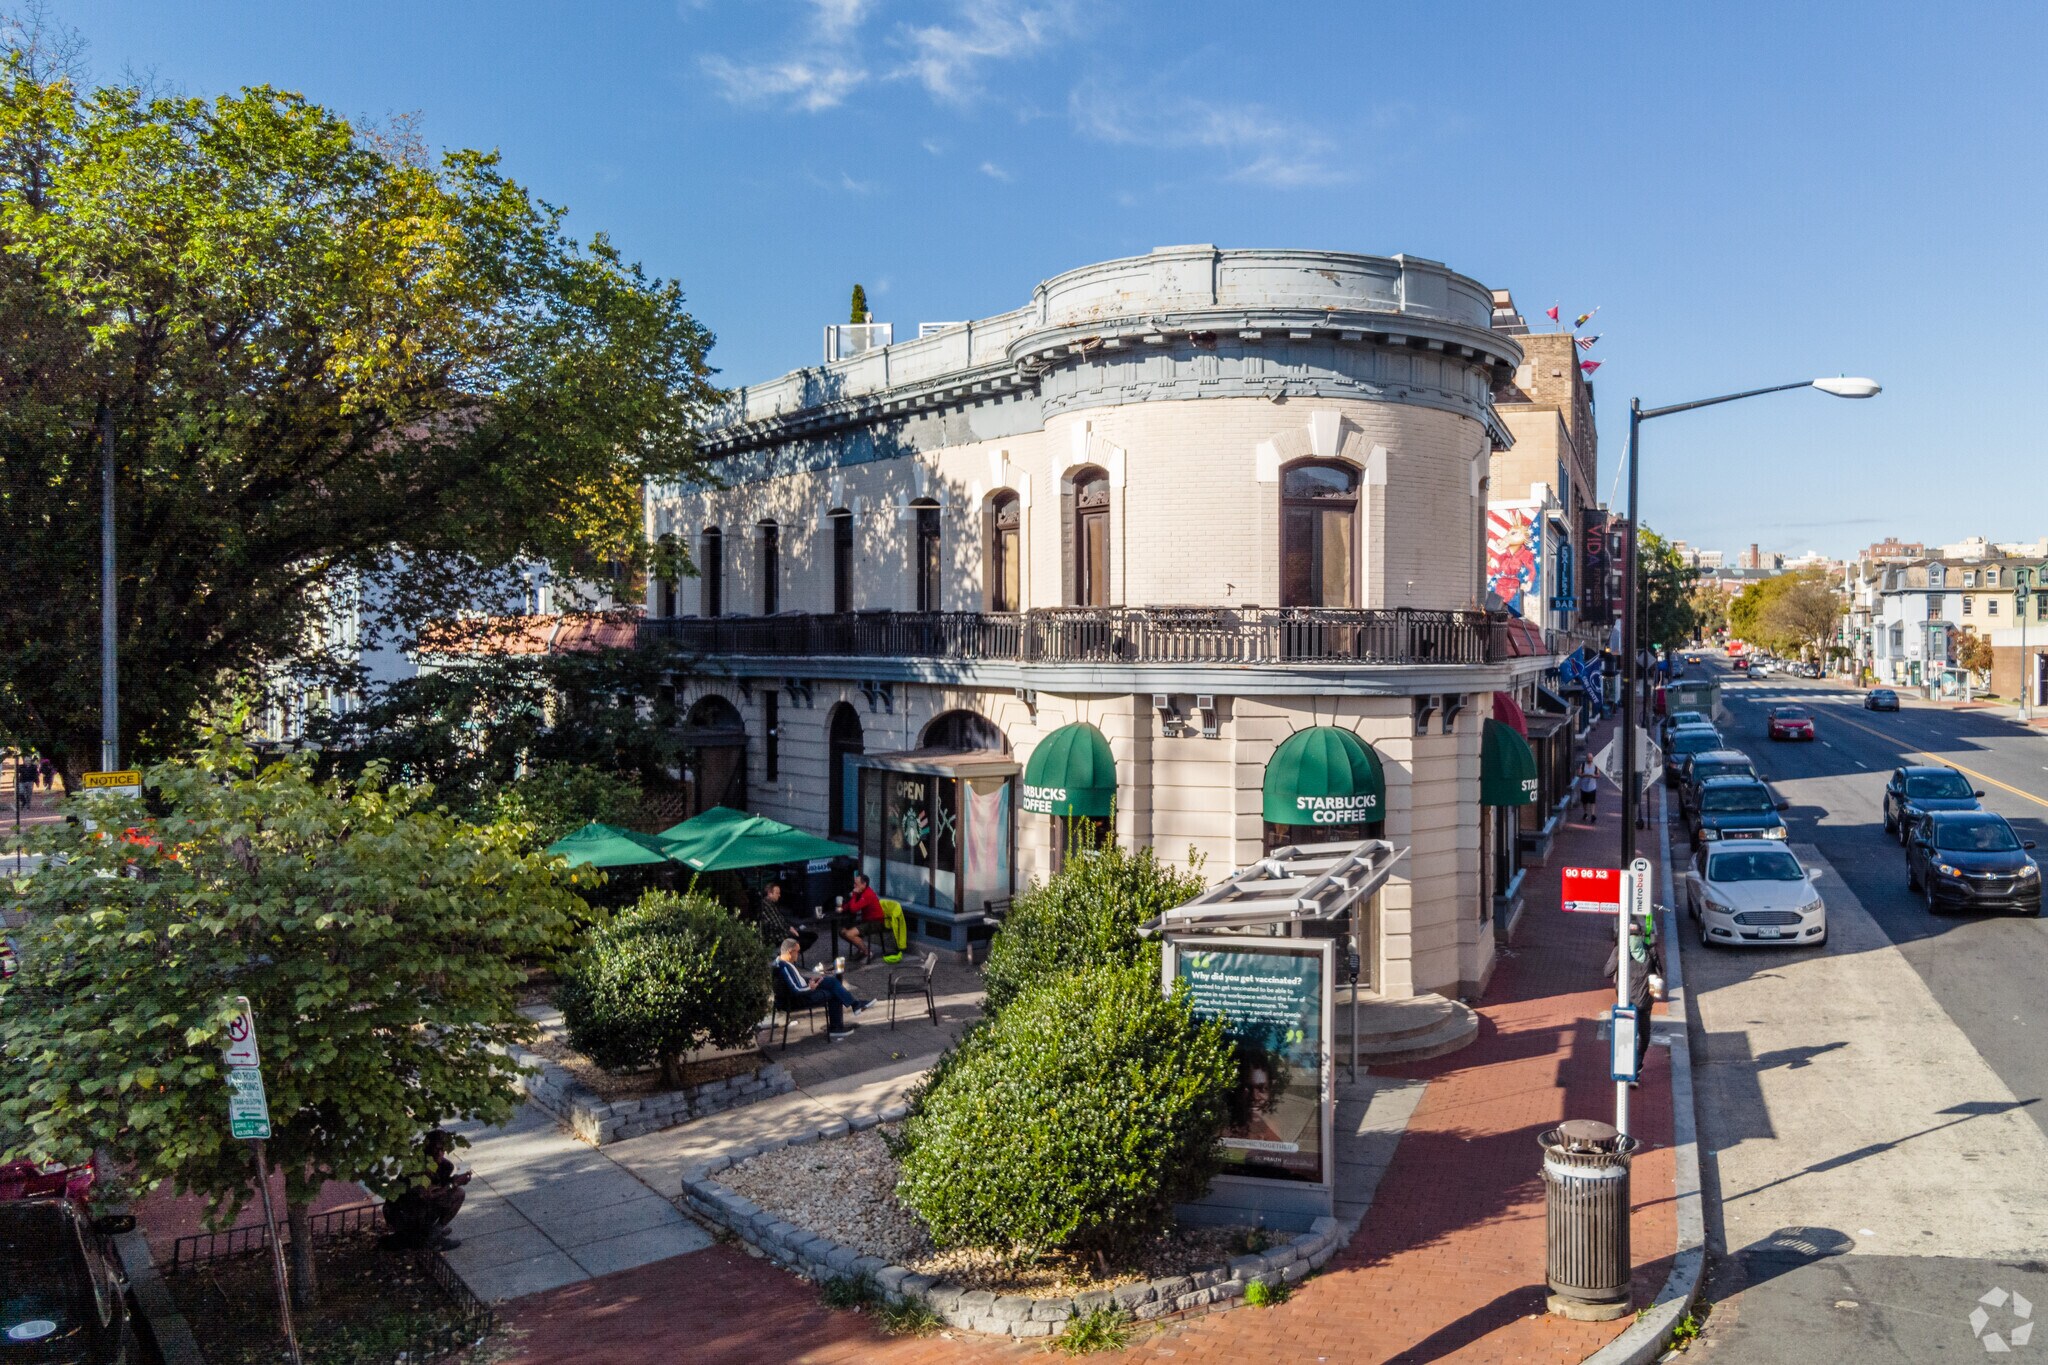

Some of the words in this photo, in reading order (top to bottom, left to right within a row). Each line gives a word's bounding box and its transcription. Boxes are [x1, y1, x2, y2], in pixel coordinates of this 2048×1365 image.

[1587, 524, 1602, 567] VIDA
[1561, 546, 1569, 597] EXILES
[1555, 600, 1574, 608] BAR
[90, 775, 134, 786] NOTICE
[897, 781, 924, 801] OPEN
[1023, 784, 1066, 801] ARBUCKS
[1297, 794, 1376, 810] STARBUCKS
[1312, 809, 1366, 823] COFFEE
[1566, 869, 1578, 877] 90
[1581, 870, 1593, 878] 96
[1596, 870, 1608, 879] X3
[1636, 873, 1644, 912] metrobus
[1191, 970, 1210, 981] Why
[1211, 971, 1224, 981] did
[1225, 975, 1240, 983] you
[1240, 975, 1254, 984] get
[1254, 976, 1303, 985] vaccinated?
